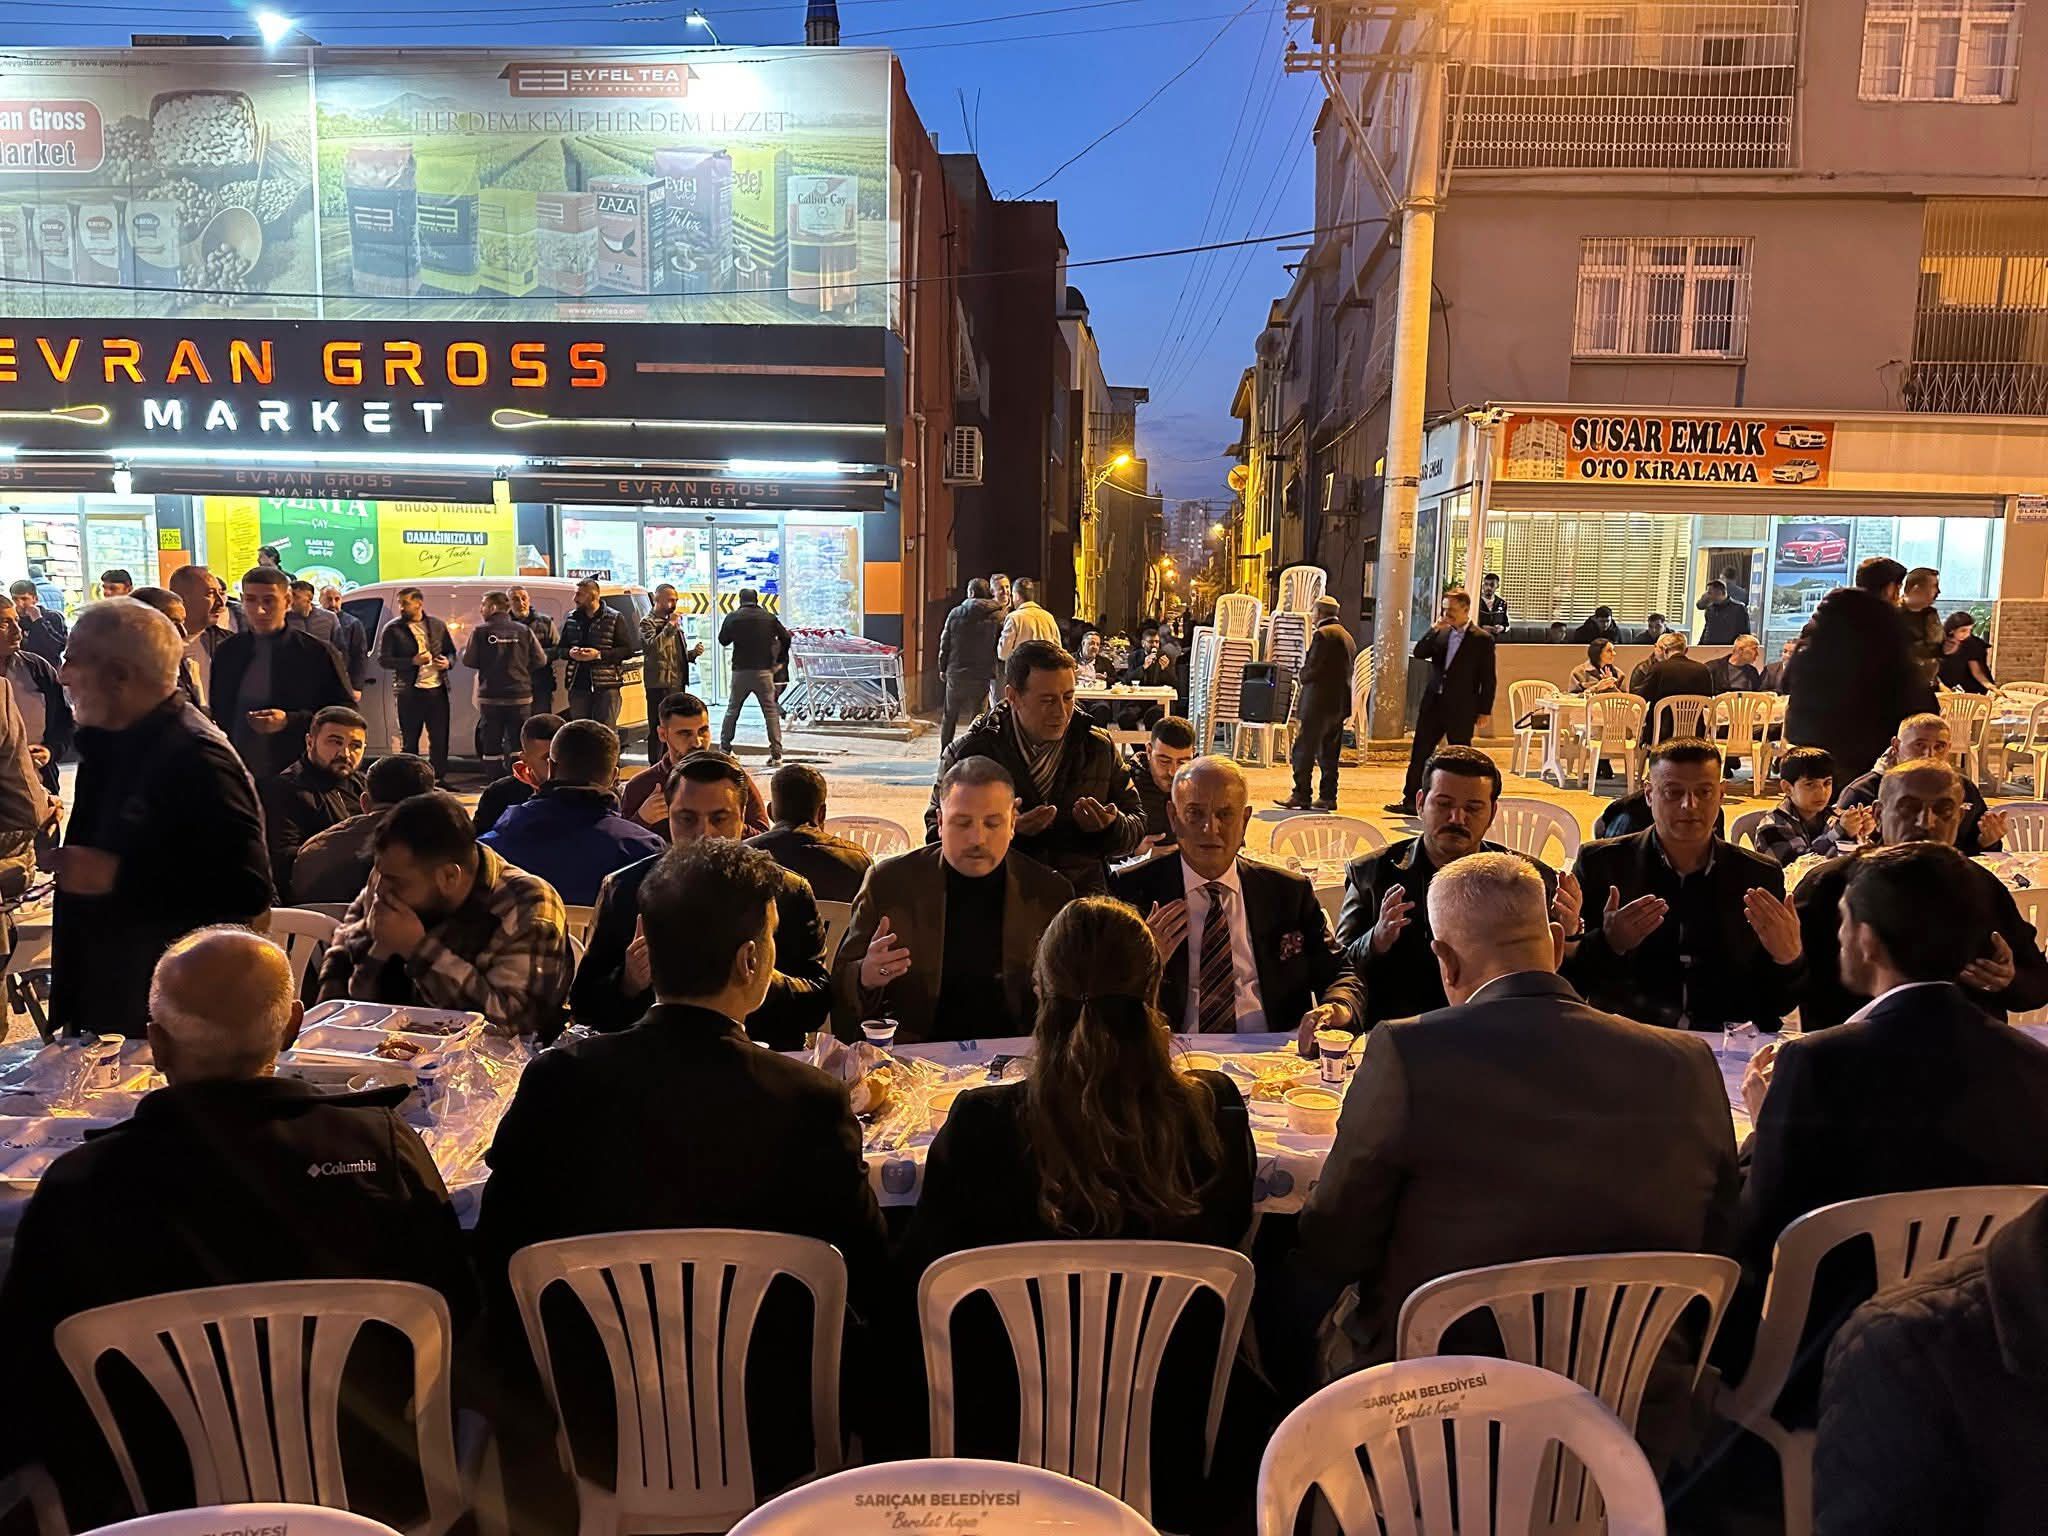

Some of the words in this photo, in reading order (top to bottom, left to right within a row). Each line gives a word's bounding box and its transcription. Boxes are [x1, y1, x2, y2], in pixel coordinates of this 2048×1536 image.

[571, 69, 634, 81] EYFEL
[639, 69, 680, 81] TEA
[30, 107, 86, 130] Gross
[415, 111, 459, 132] HER
[468, 111, 519, 132] DEM
[596, 111, 643, 132] HER
[650, 111, 700, 132] DEM
[664, 175, 697, 193] Eyfel
[599, 196, 636, 214] ZAZA
[323, 341, 607, 388] GROSS
[143, 399, 444, 433] MARKET
[1572, 417, 1663, 453] SUSAR
[1668, 420, 1767, 456] EMLAK
[1581, 458, 1629, 478] OTO
[235, 471, 312, 485] EVRAN
[325, 473, 393, 488] GROSS
[618, 481, 697, 494] EVRAN
[710, 483, 780, 497] GROSS
[274, 487, 353, 498] MARKET
[659, 497, 739, 507] MARKET
[321, 1159, 377, 1176] Columbia
[1362, 1389, 1418, 1409] SARIÇAM
[1419, 1373, 1488, 1399] BELEDİYESİ
[855, 1493, 926, 1509] SARIÇAM
[930, 1489, 1021, 1506] BELEDİYESİ
